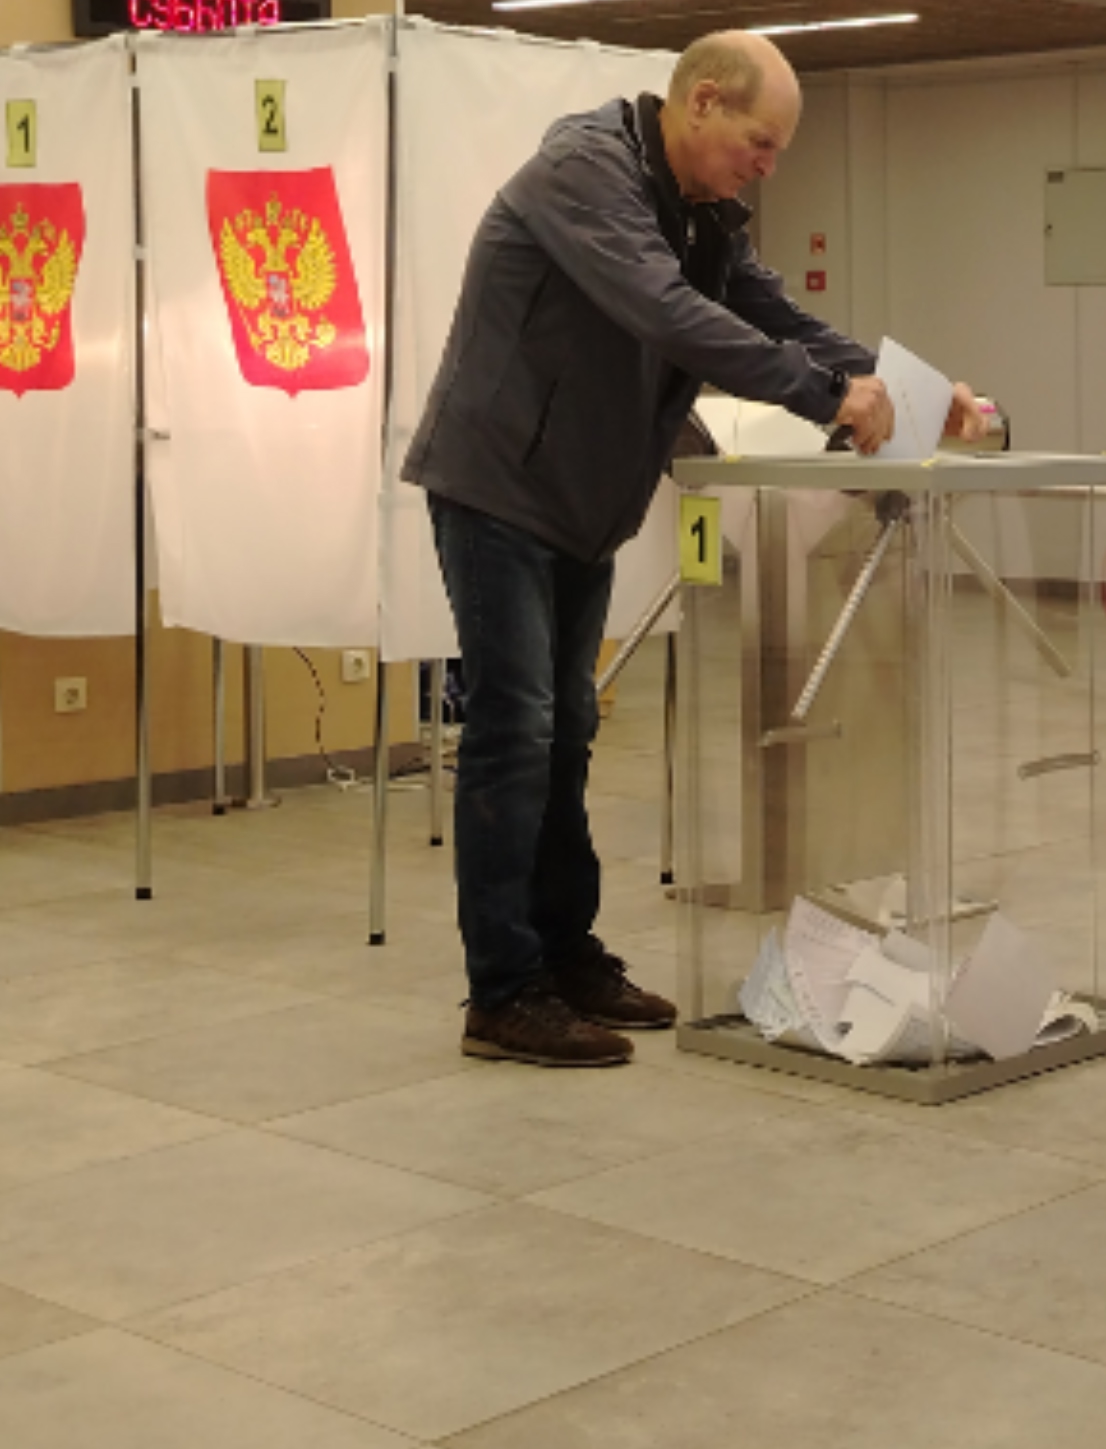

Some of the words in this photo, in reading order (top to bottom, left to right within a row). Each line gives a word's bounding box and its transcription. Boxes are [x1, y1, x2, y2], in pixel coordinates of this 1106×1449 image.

[16, 113, 30, 153] 1
[262, 94, 279, 135] 2
[690, 515, 706, 563] 1
